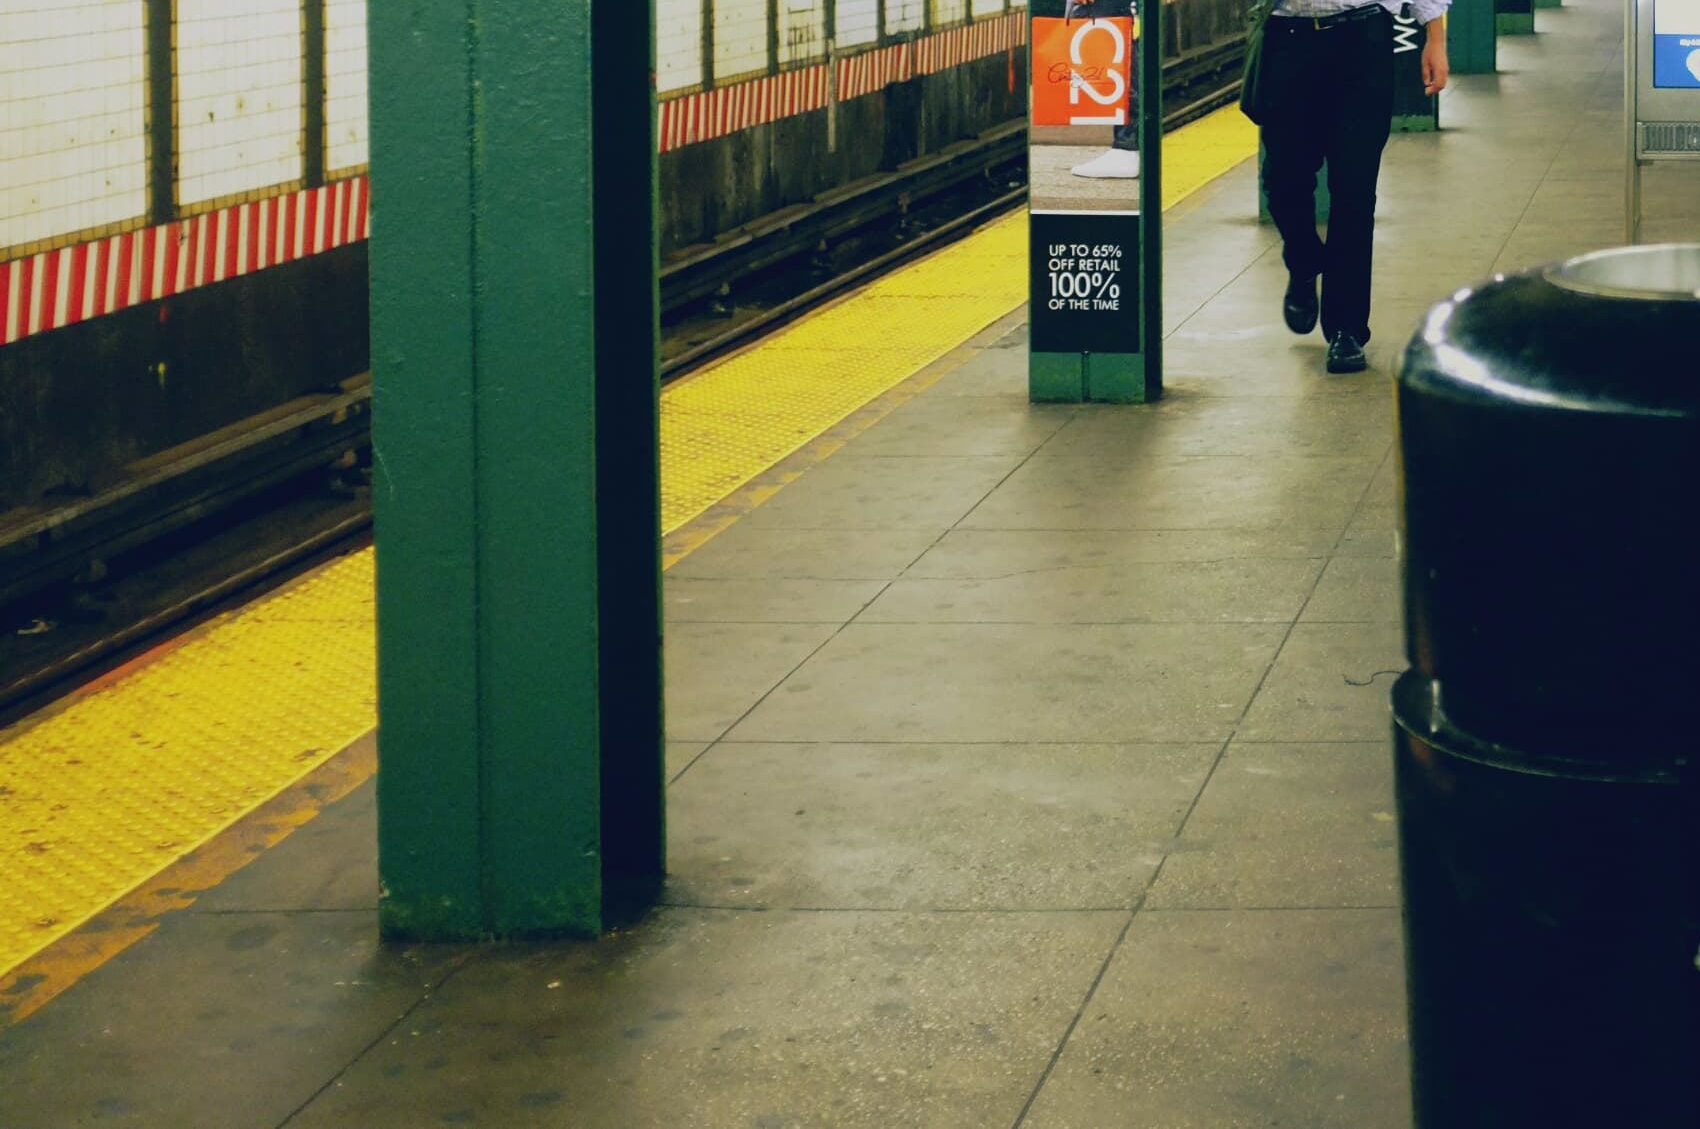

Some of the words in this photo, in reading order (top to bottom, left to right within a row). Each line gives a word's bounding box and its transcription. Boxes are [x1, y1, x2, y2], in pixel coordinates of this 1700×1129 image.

[1069, 18, 1125, 126] C21
[1049, 244, 1067, 257] UP
[1069, 244, 1089, 257] TO
[1092, 244, 1122, 258] 65%
[1048, 258, 1075, 271] OFF
[1078, 258, 1121, 271] RETAIL
[1048, 271, 1120, 299] 100%
[1048, 298, 1066, 310] OF
[1068, 298, 1090, 310] THE
[1092, 299, 1120, 311] TIME
